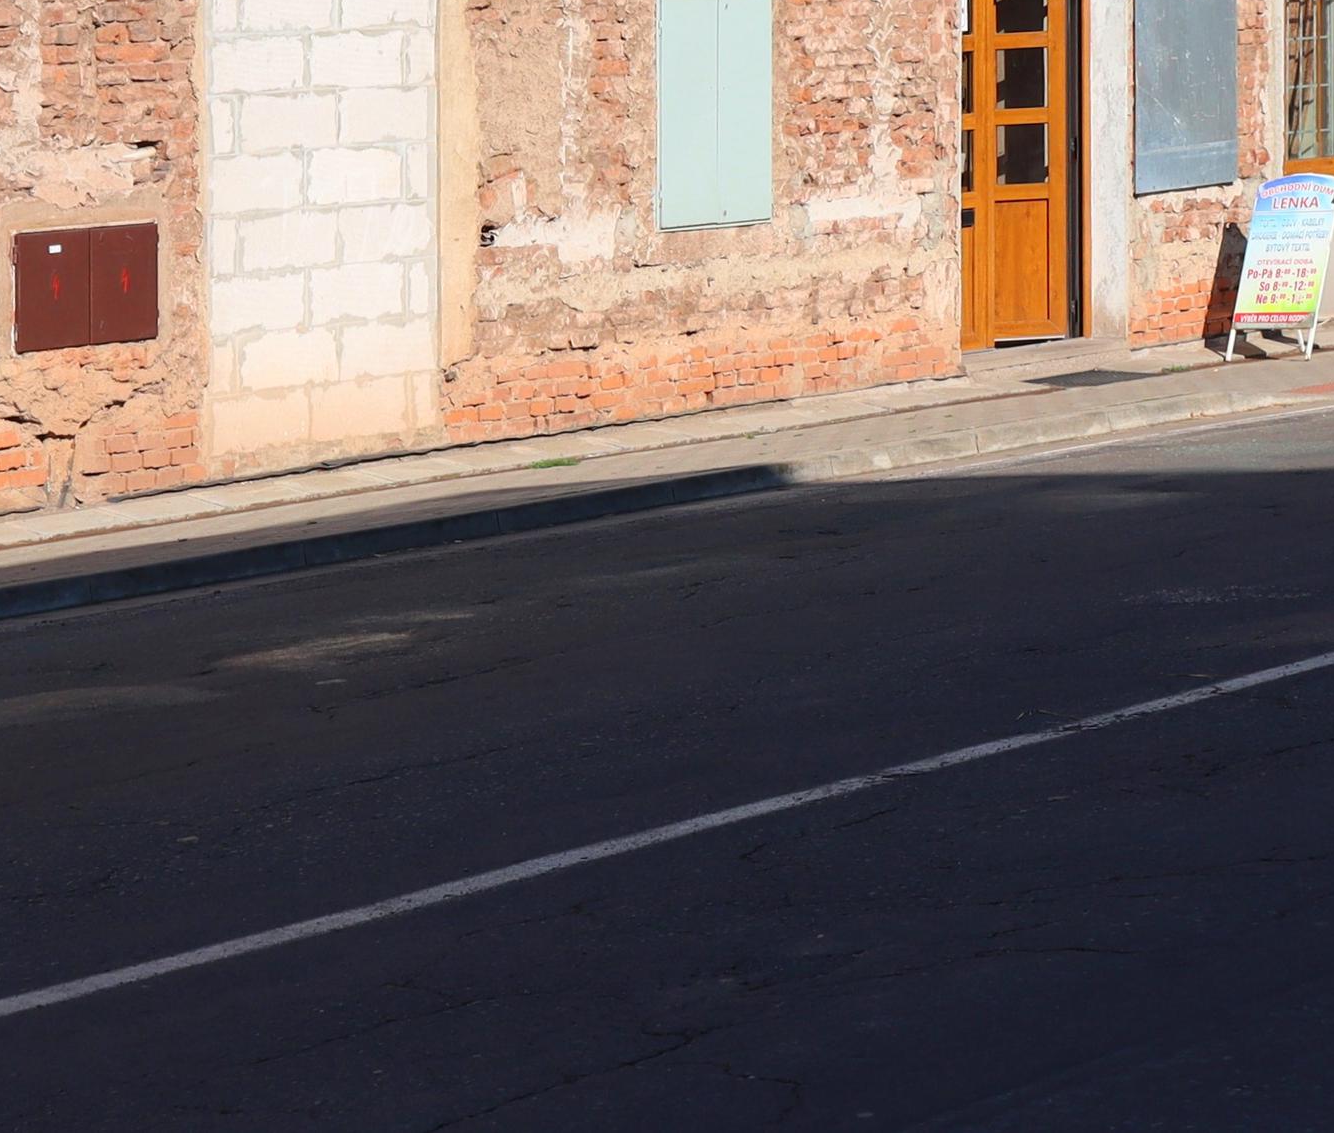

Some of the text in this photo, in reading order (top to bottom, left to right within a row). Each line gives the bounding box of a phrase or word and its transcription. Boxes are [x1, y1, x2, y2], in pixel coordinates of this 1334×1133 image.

[1273, 196, 1319, 209] LENKA
[1259, 281, 1270, 291] So
[1255, 293, 1268, 305] Ne
